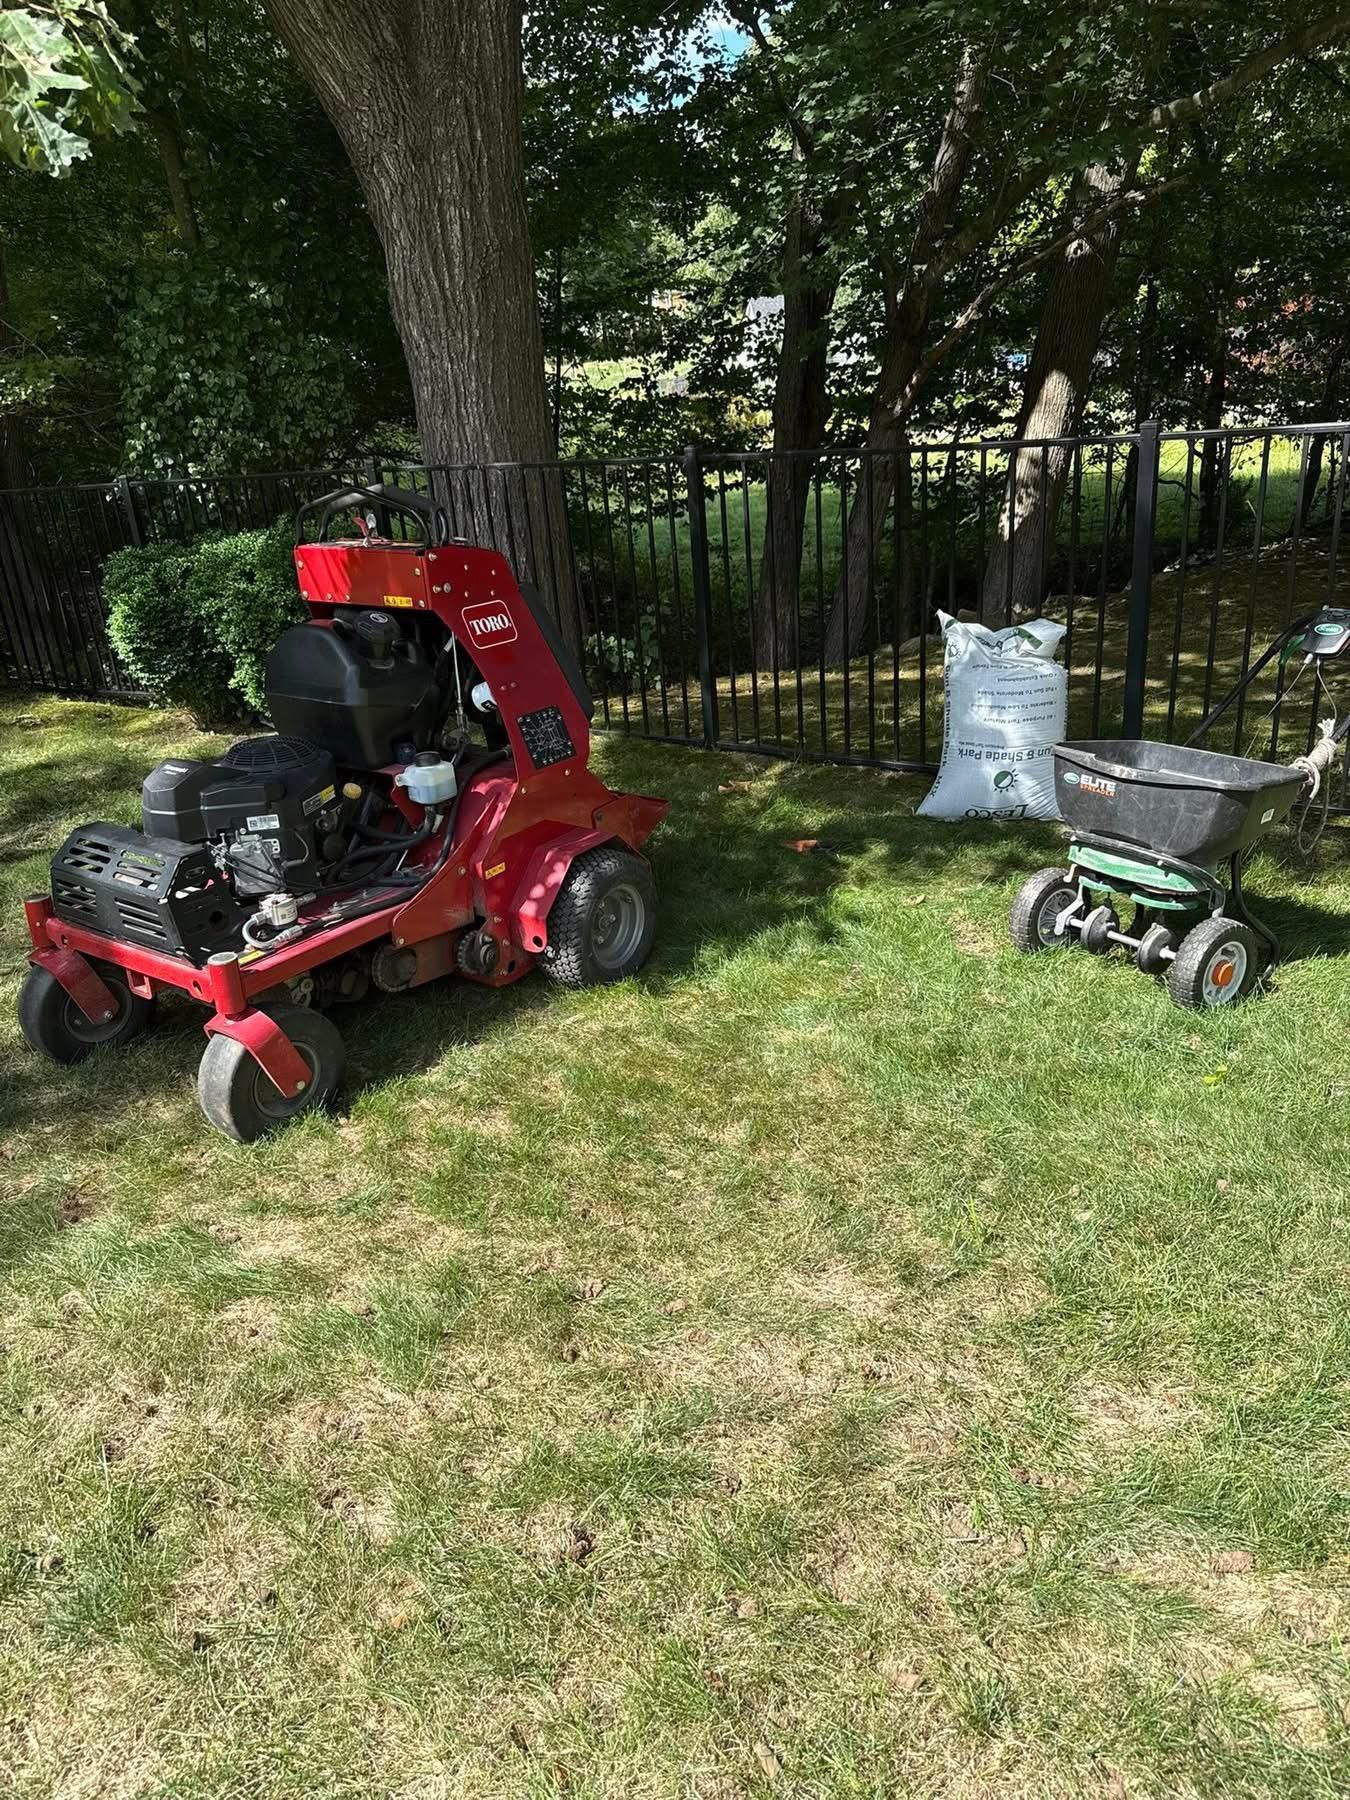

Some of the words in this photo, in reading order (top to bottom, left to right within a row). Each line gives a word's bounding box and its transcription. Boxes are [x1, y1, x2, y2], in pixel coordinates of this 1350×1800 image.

[469, 613, 510, 636] TORO
[958, 748, 982, 760] Park
[986, 752, 1024, 763] Shade
[1026, 750, 1035, 760] &
[1080, 774, 1117, 792] ELITE
[1080, 784, 1115, 797] SPREADER
